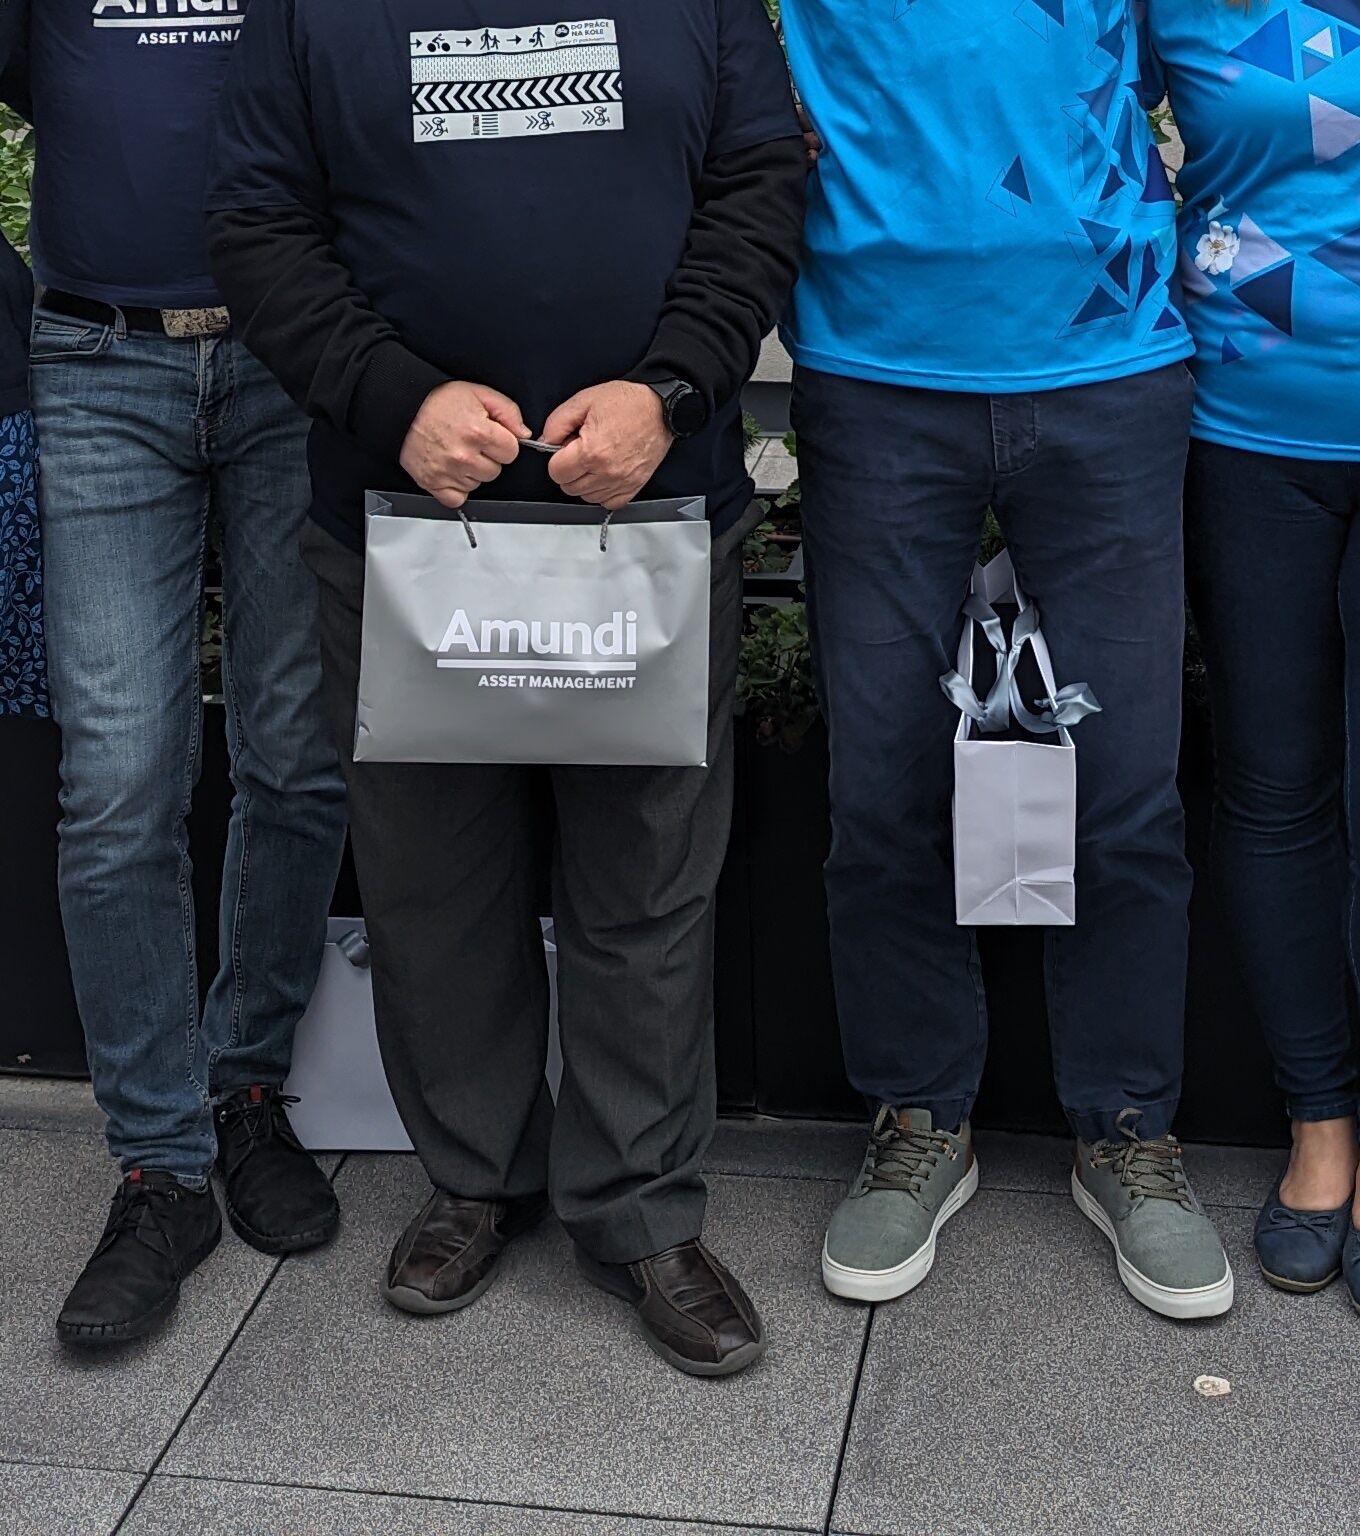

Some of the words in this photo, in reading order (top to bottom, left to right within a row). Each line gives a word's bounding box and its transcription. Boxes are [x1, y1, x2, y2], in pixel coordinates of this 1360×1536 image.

[570, 23, 583, 31] DO
[137, 31, 189, 45] ASSET
[437, 608, 638, 656] Amundi
[478, 675, 526, 688] ASSET
[529, 675, 637, 689] MANAGEMENT
